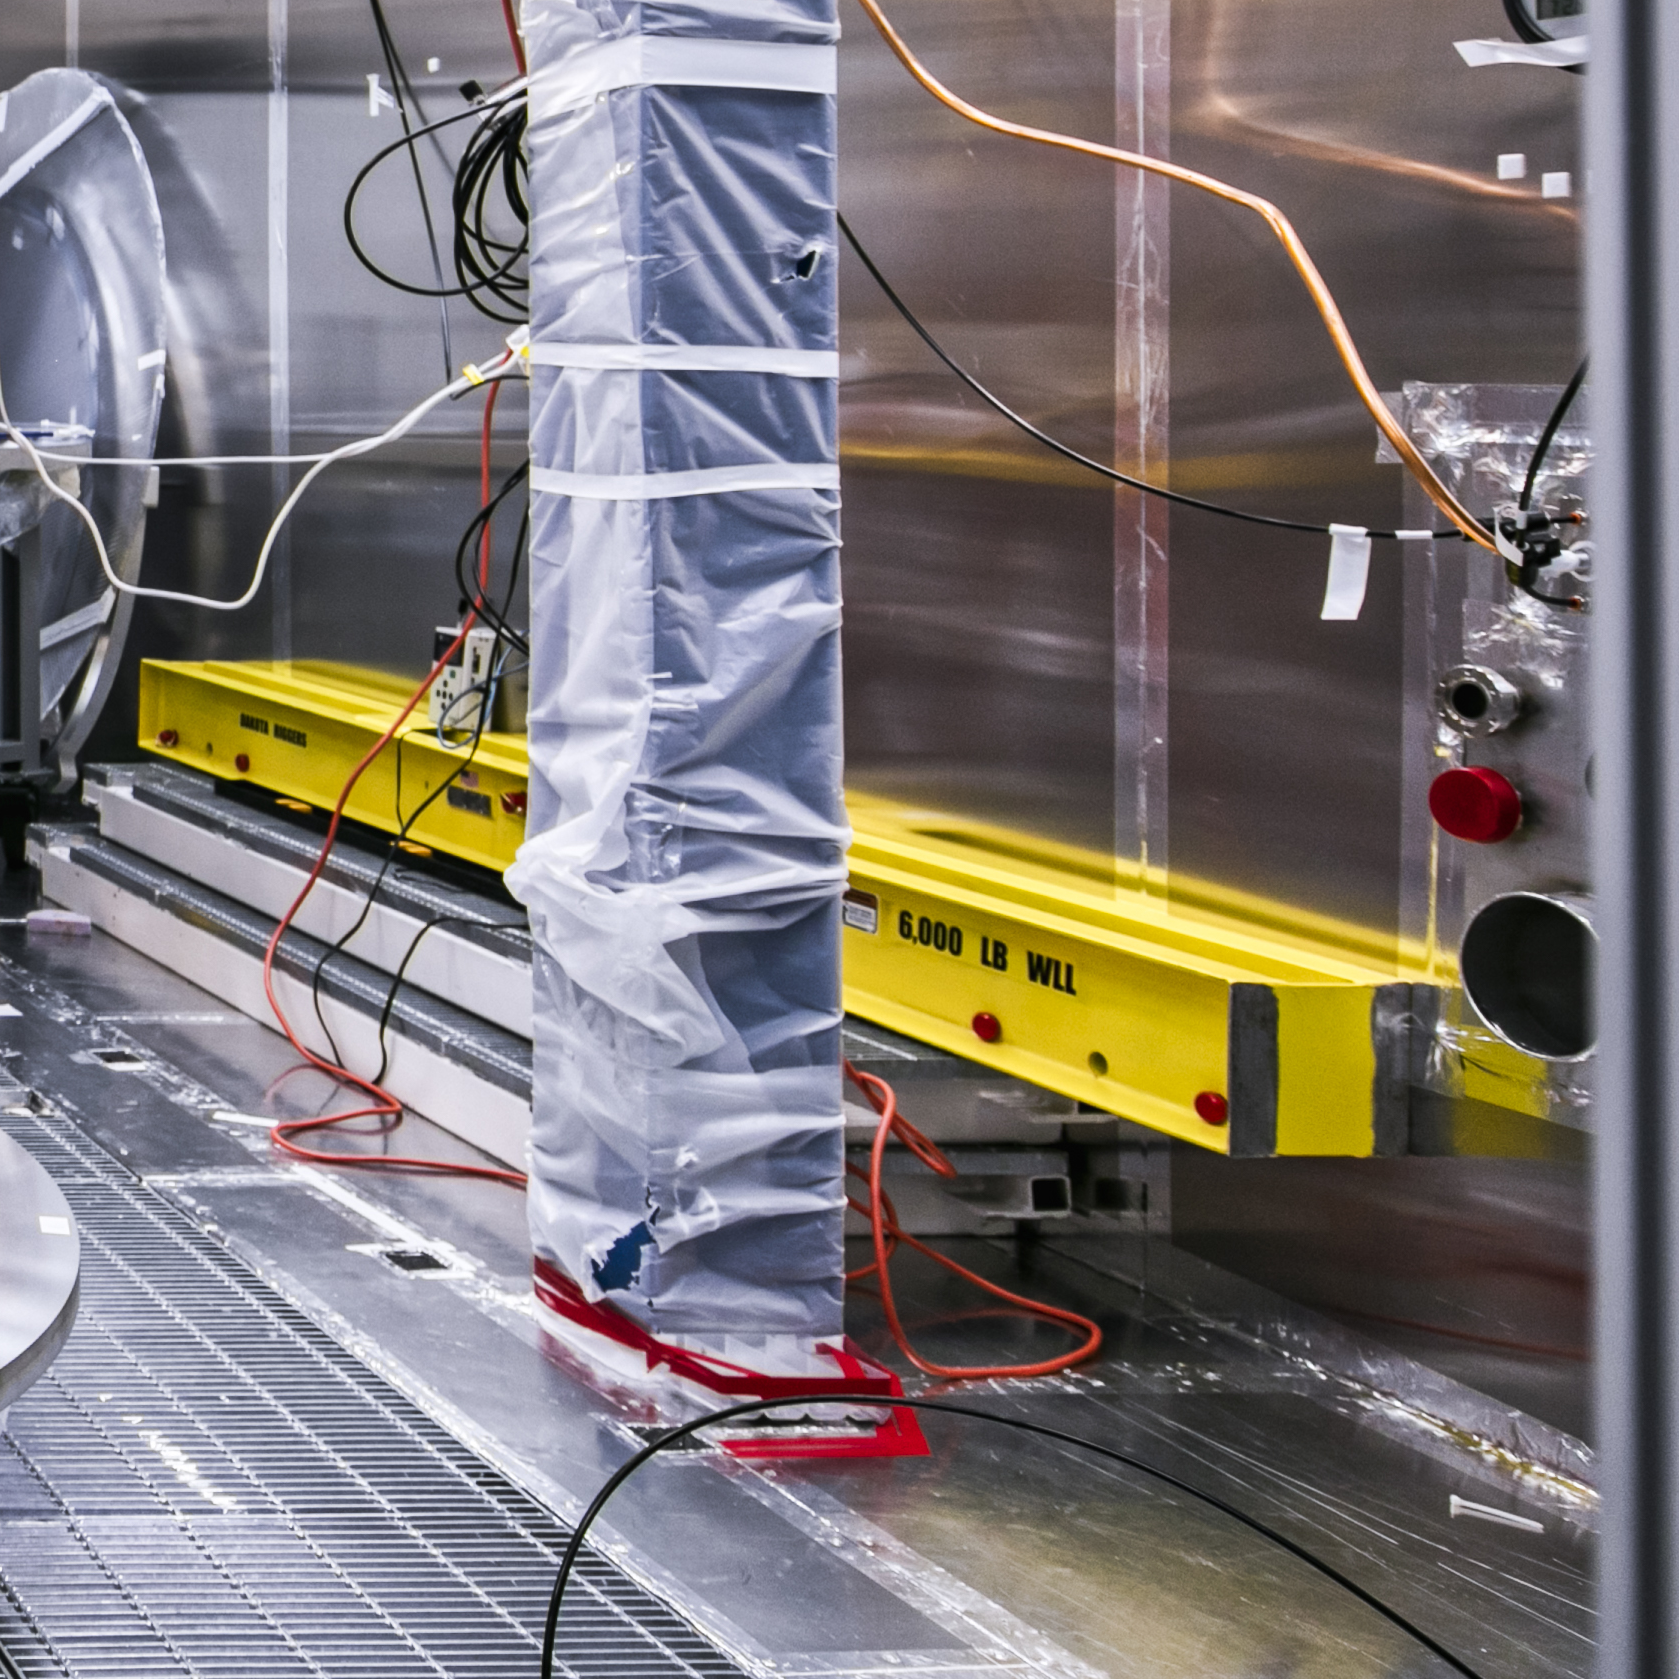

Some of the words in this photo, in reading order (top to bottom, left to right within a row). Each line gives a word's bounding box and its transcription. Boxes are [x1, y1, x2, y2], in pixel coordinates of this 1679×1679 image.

[240, 712, 269, 736] DAKOTA
[273, 723, 307, 749] RIGGERS
[898, 909, 963, 957] 6,000
[980, 935, 1008, 972] LB
[1027, 950, 1077, 996] WLL
